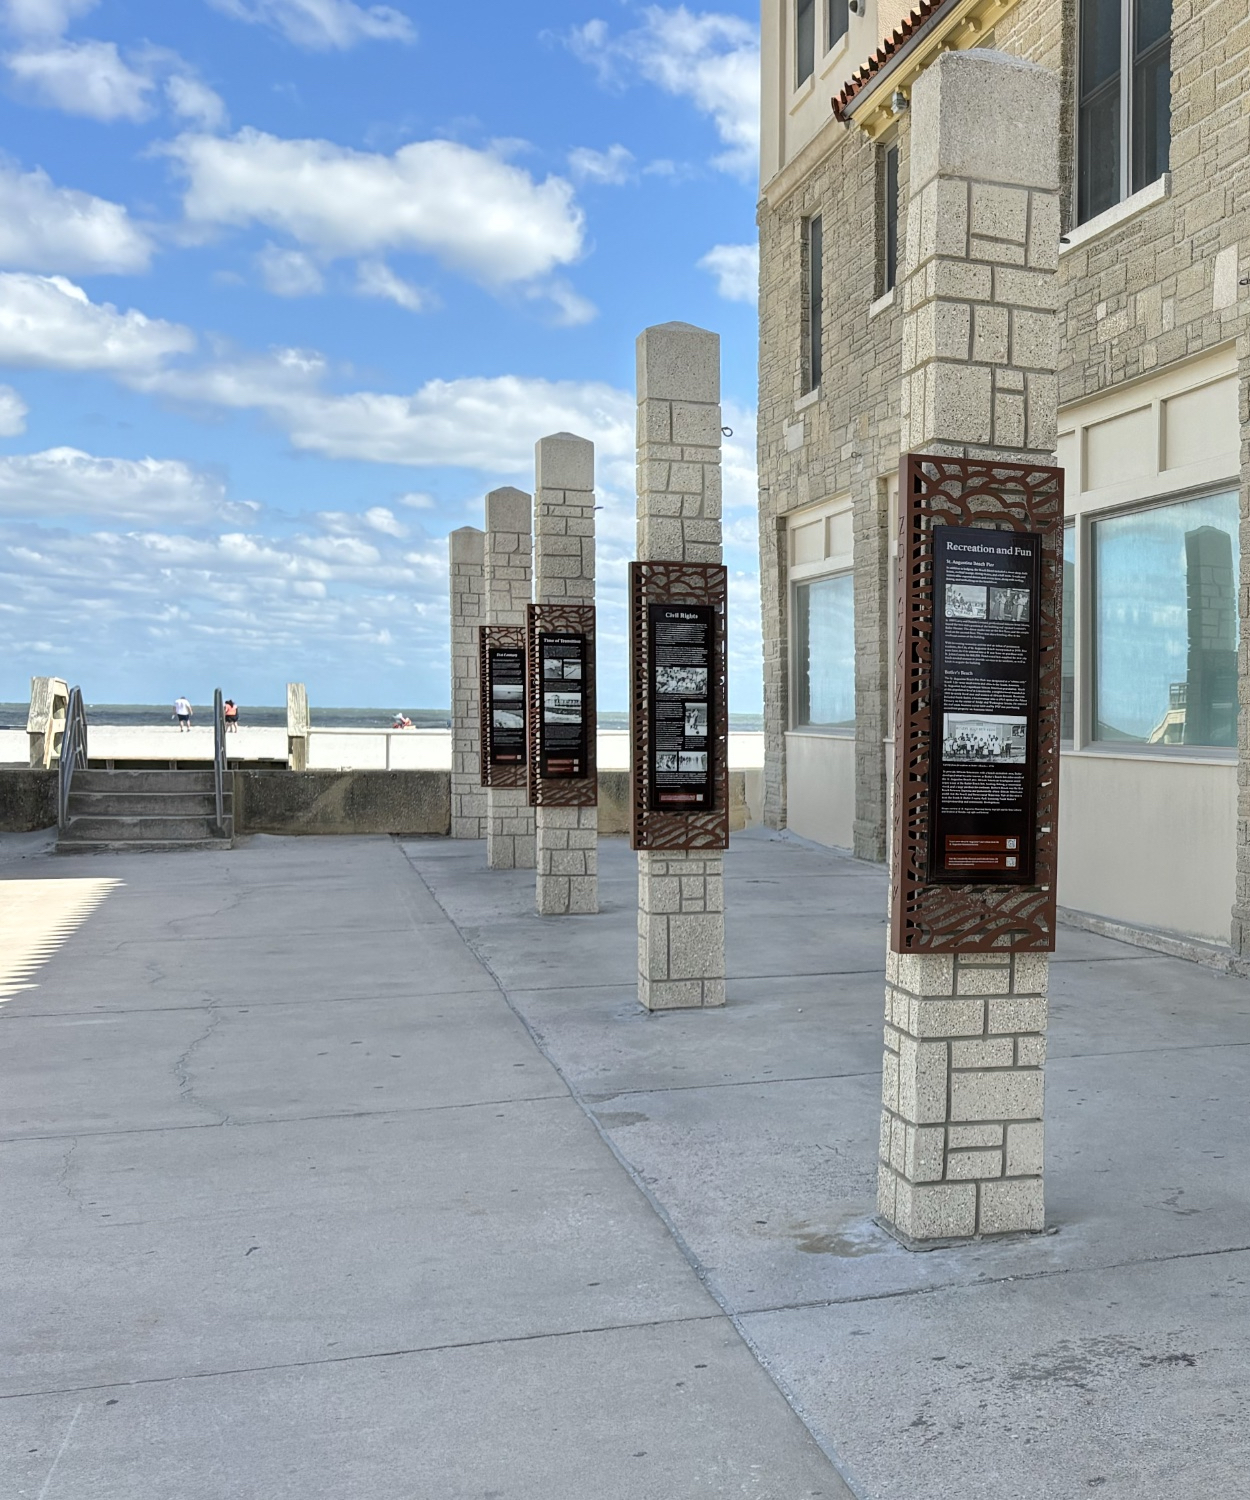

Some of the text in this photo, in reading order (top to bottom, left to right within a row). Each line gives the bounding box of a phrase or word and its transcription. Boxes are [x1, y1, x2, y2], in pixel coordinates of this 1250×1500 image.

[946, 541, 1032, 557] Recreation and Fun
[665, 611, 699, 620] Civil Rights
